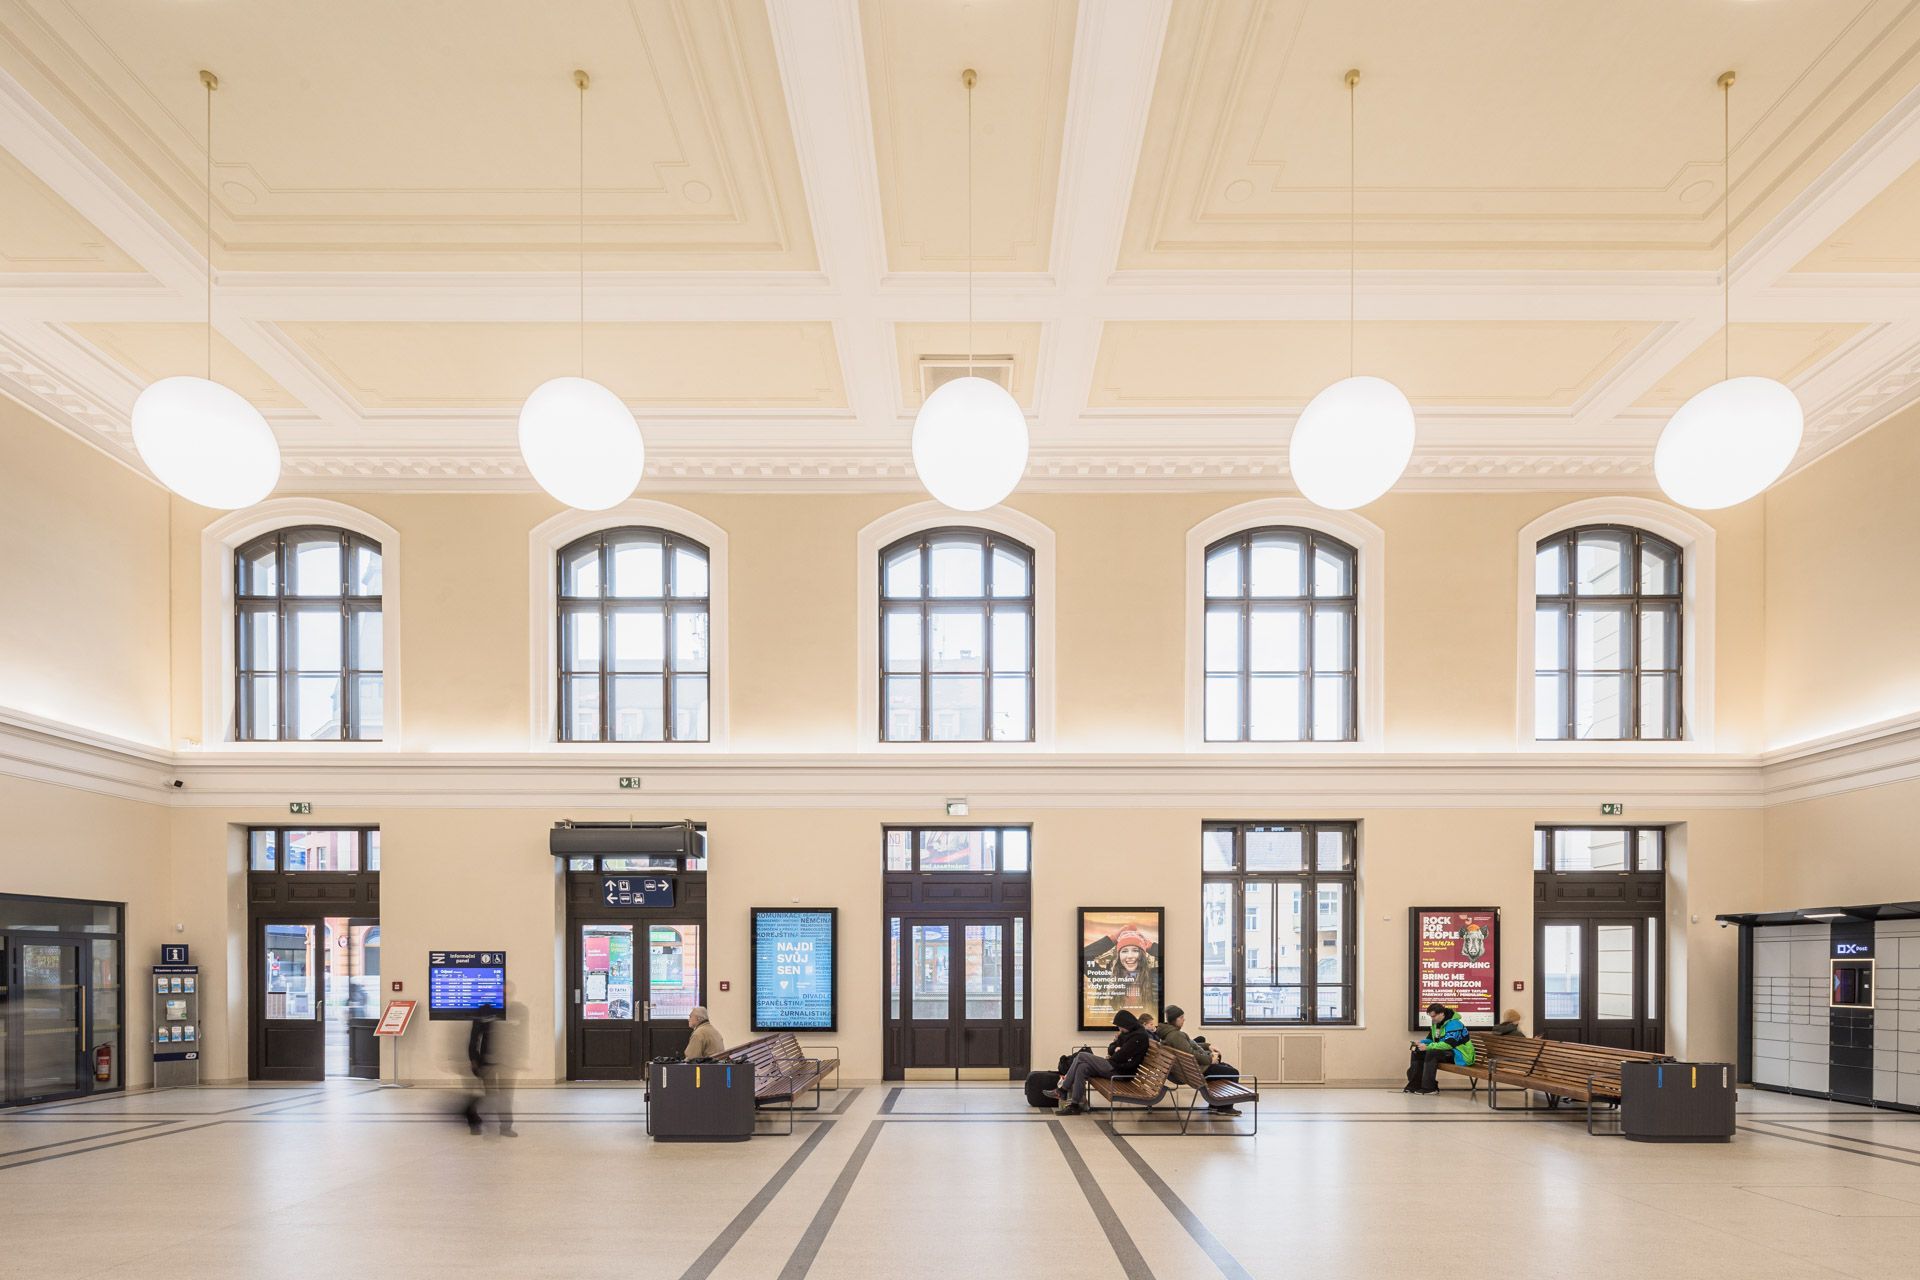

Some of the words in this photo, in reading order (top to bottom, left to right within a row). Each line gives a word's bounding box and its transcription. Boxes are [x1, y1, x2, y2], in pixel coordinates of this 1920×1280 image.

[1423, 916, 1451, 924] ROCK
[777, 942, 813, 951] NAJDI
[777, 951, 809, 963] SVŮJ
[777, 965, 801, 975] SEN
